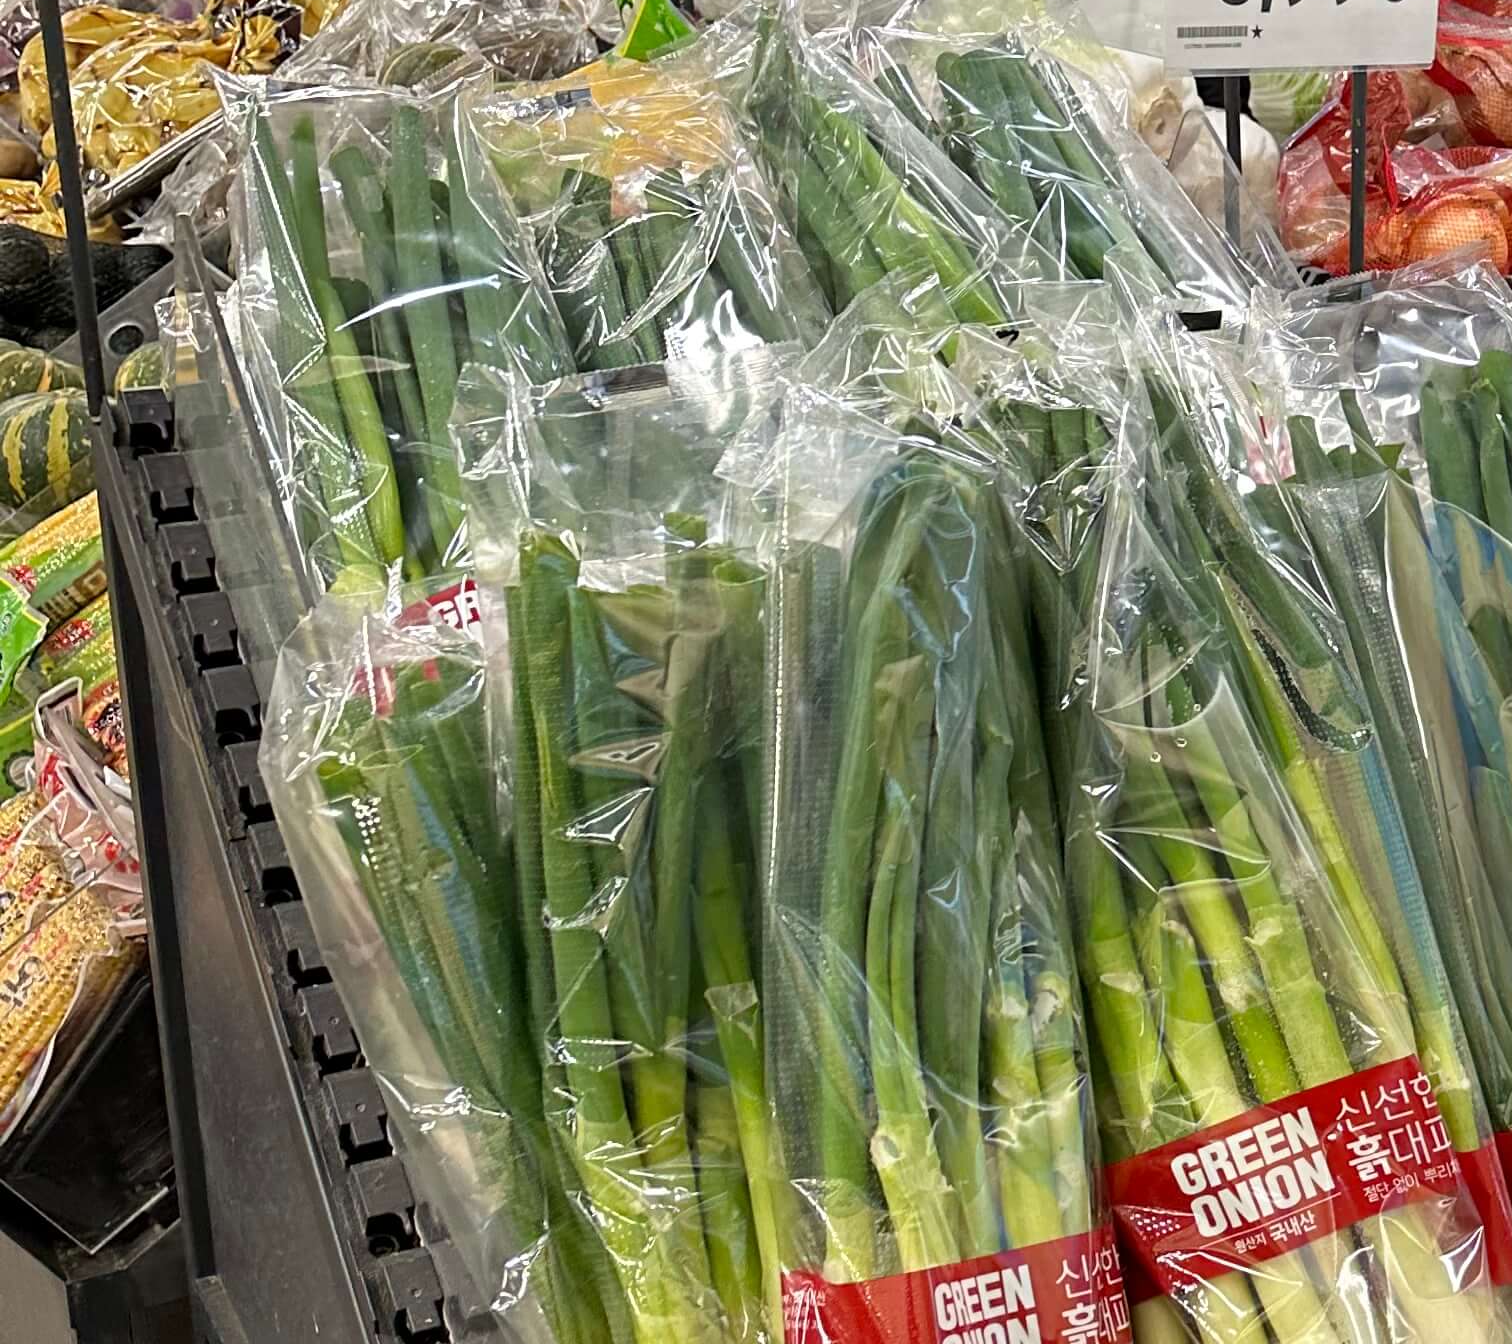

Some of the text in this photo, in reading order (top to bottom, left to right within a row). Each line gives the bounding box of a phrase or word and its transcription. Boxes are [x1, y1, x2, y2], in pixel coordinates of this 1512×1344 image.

[1170, 1106, 1320, 1196] GREEN
[1190, 1150, 1336, 1238] ONION
[1363, 1181, 1390, 1204] 절단
[1392, 1172, 1420, 1194] 없이
[1234, 1210, 1318, 1255] 원산지 국내산
[934, 1263, 1036, 1332] GREEN
